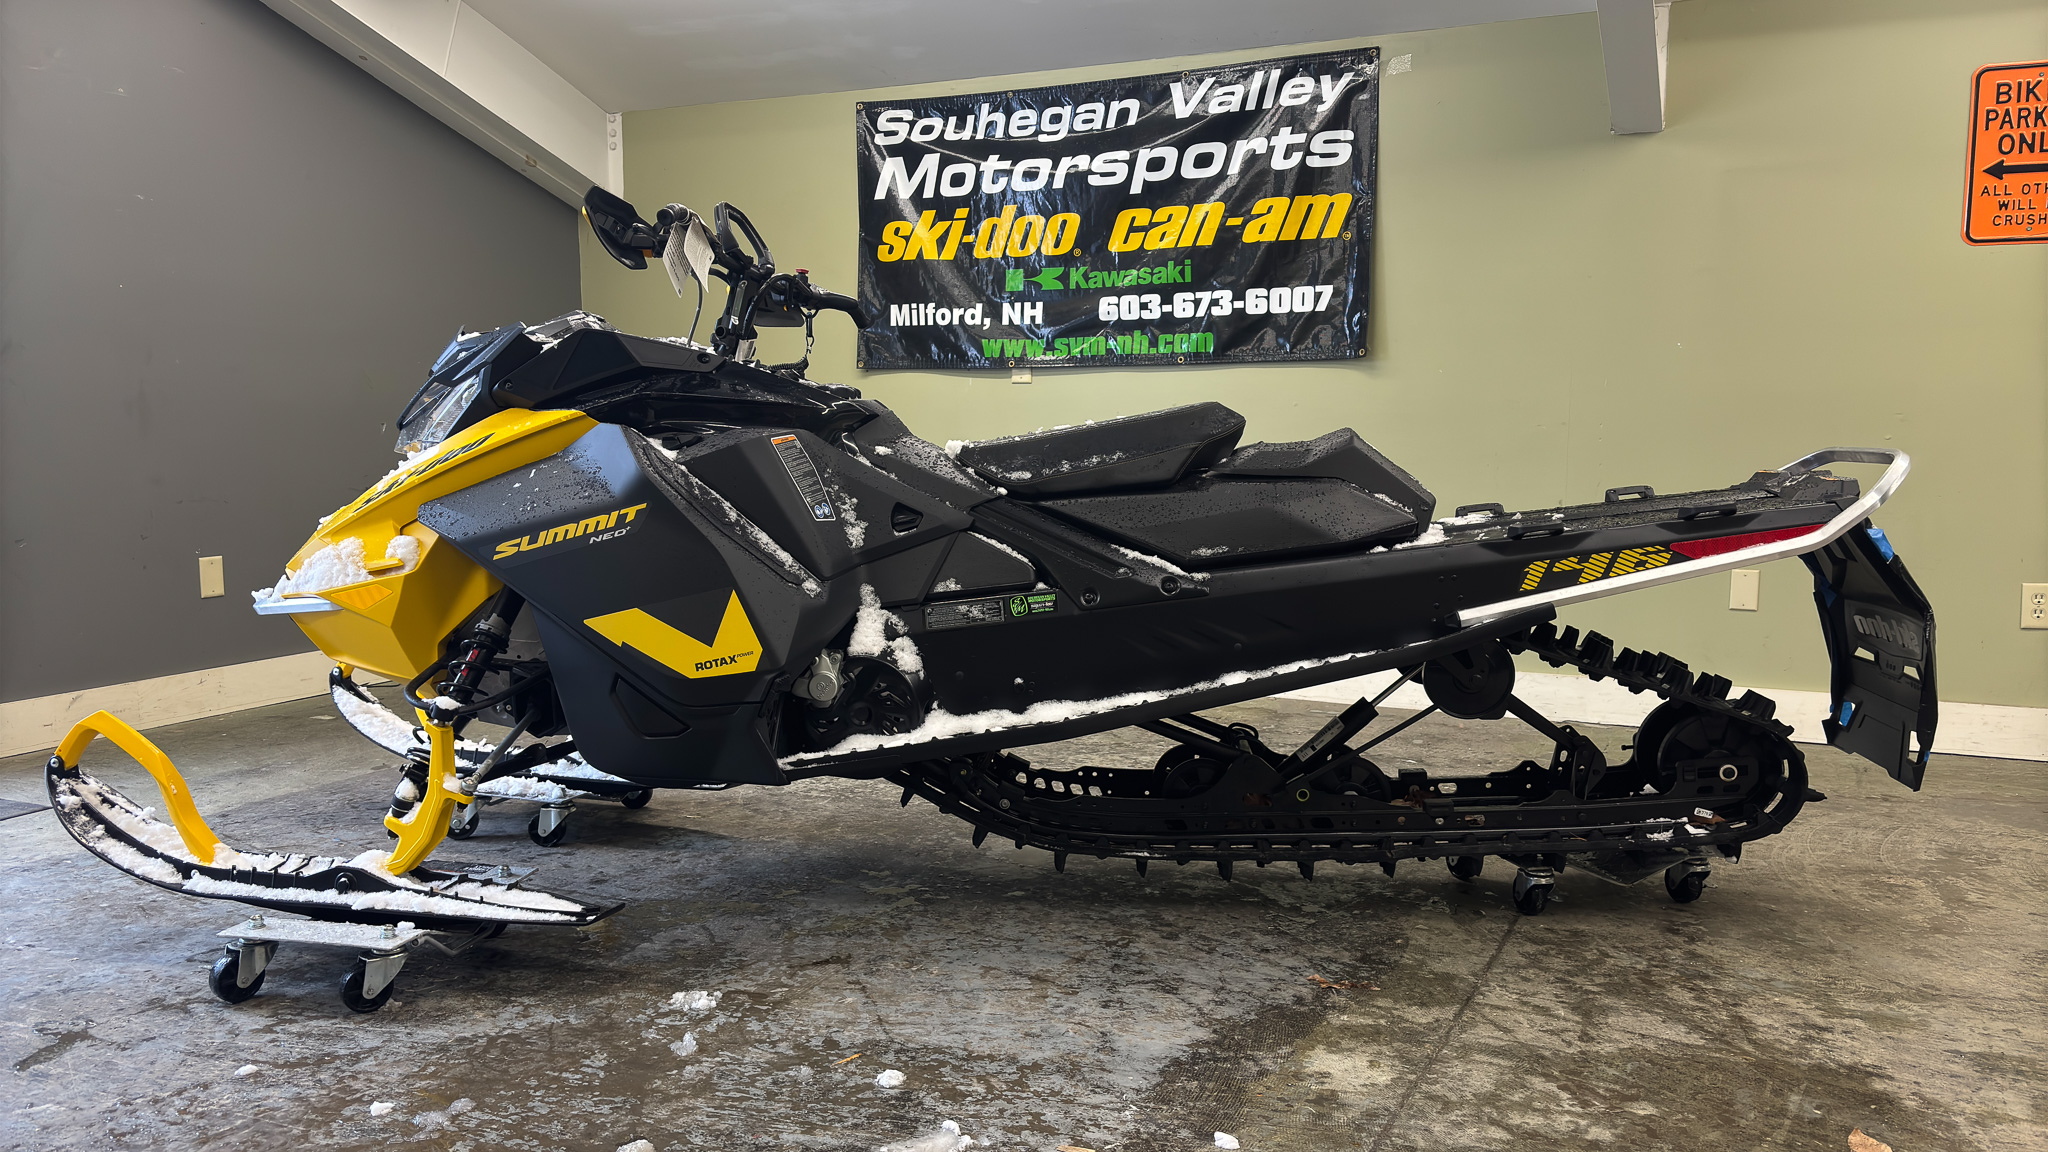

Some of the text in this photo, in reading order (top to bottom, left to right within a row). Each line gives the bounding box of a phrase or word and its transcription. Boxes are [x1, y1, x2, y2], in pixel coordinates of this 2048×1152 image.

[874, 68, 1355, 146] Souhegan Valley
[1995, 79, 2048, 105] BIK
[874, 126, 1355, 200] Motorsports
[1980, 184, 2013, 197] ALL
[1998, 198, 2037, 211] WILL
[877, 192, 1353, 262] ski-doo can-am
[1992, 213, 2048, 226] CRUSH
[1069, 259, 1192, 289] Kawasaki
[889, 284, 1334, 330] Milford, NH 603-673-6007
[981, 330, 1214, 358] www.svm-nh.com
[492, 502, 648, 561] SUMMIT
[1519, 545, 1674, 592] 146
[695, 650, 754, 672] ROTAX POWER
